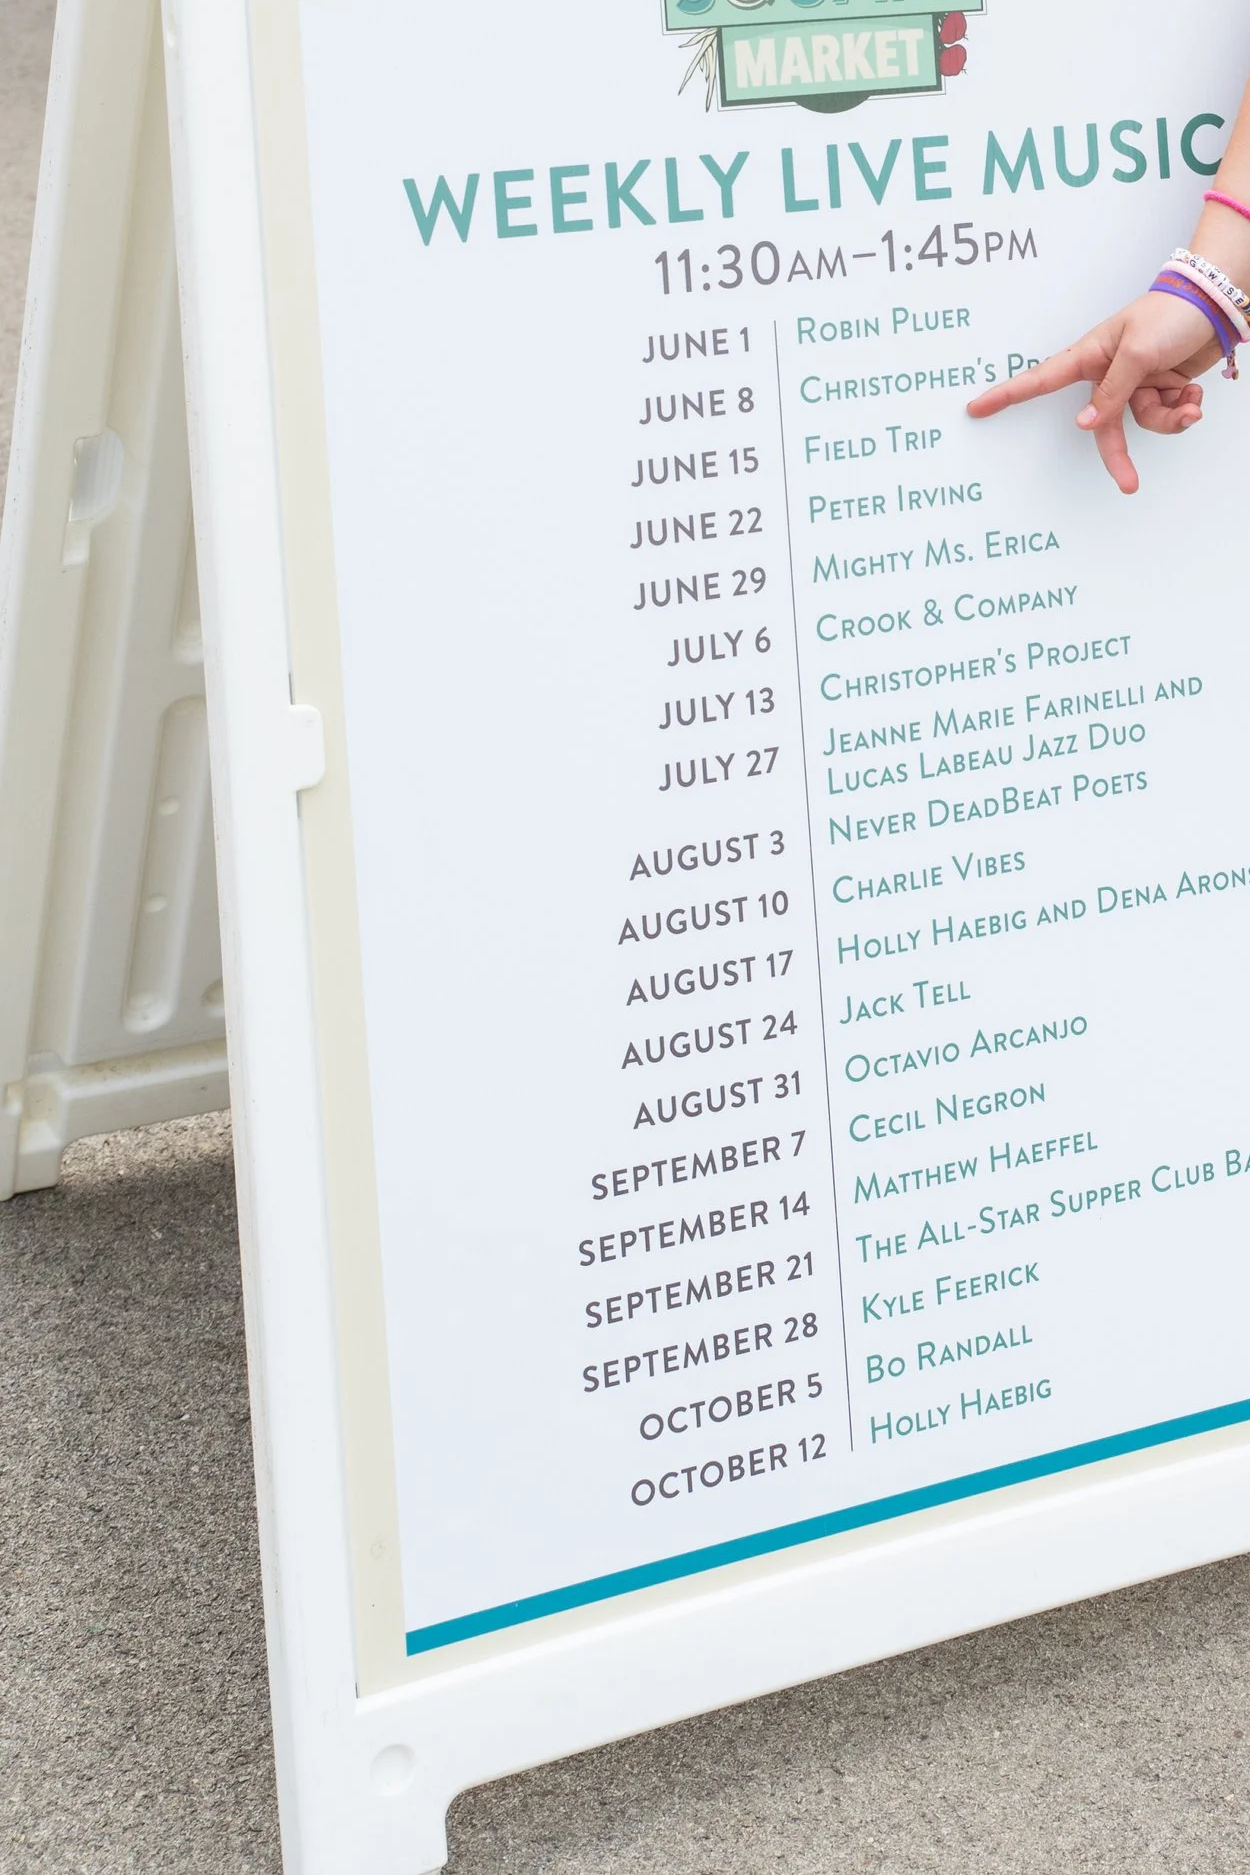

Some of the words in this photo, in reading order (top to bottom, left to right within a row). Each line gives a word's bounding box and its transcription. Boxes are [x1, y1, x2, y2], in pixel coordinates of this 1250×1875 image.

[734, 27, 924, 89] MARKET
[402, 150, 751, 247] WEEKLY
[780, 134, 953, 214] LIVE
[982, 112, 1226, 196] MUSIC
[641, 327, 730, 364] JUNE
[739, 326, 750, 353] 1
[638, 388, 727, 426] JUNE
[737, 386, 755, 414] 8
[630, 450, 719, 488] JUNE
[728, 446, 760, 476] 15
[629, 511, 718, 550] JUNE
[727, 506, 763, 537] 22
[632, 571, 721, 611] JUNE
[731, 566, 767, 597] 29
[923, 598, 945, 627] &
[666, 629, 744, 668] JULY
[754, 625, 772, 654] 6
[658, 691, 736, 730] JULY
[745, 686, 776, 716] 13
[658, 752, 736, 792] JULY
[745, 745, 780, 778] 27
[629, 832, 760, 882] AUGUST
[769, 829, 785, 856] 3
[617, 895, 749, 946] AUGUST
[757, 889, 789, 919] 10
[625, 955, 757, 1007] AUGUST
[765, 948, 794, 979] 17
[620, 1017, 752, 1070] AUGUST
[761, 1009, 799, 1041] 24
[632, 1076, 764, 1130] AUGUST
[773, 1069, 801, 1100] 31
[591, 1135, 782, 1201] SEPTEMBER
[790, 1129, 807, 1158] 7
[578, 1199, 769, 1267] SEPTEMBER
[778, 1190, 811, 1221] 14
[585, 1260, 776, 1329] SEPTEMBER
[785, 1250, 814, 1282] 21
[582, 1322, 774, 1394] SEPTEMBER
[783, 1311, 819, 1344] 28
[639, 1378, 797, 1441] OCTOBER
[806, 1371, 823, 1399] 5
[630, 1442, 789, 1507] OCTOBER
[797, 1433, 827, 1463] 12
